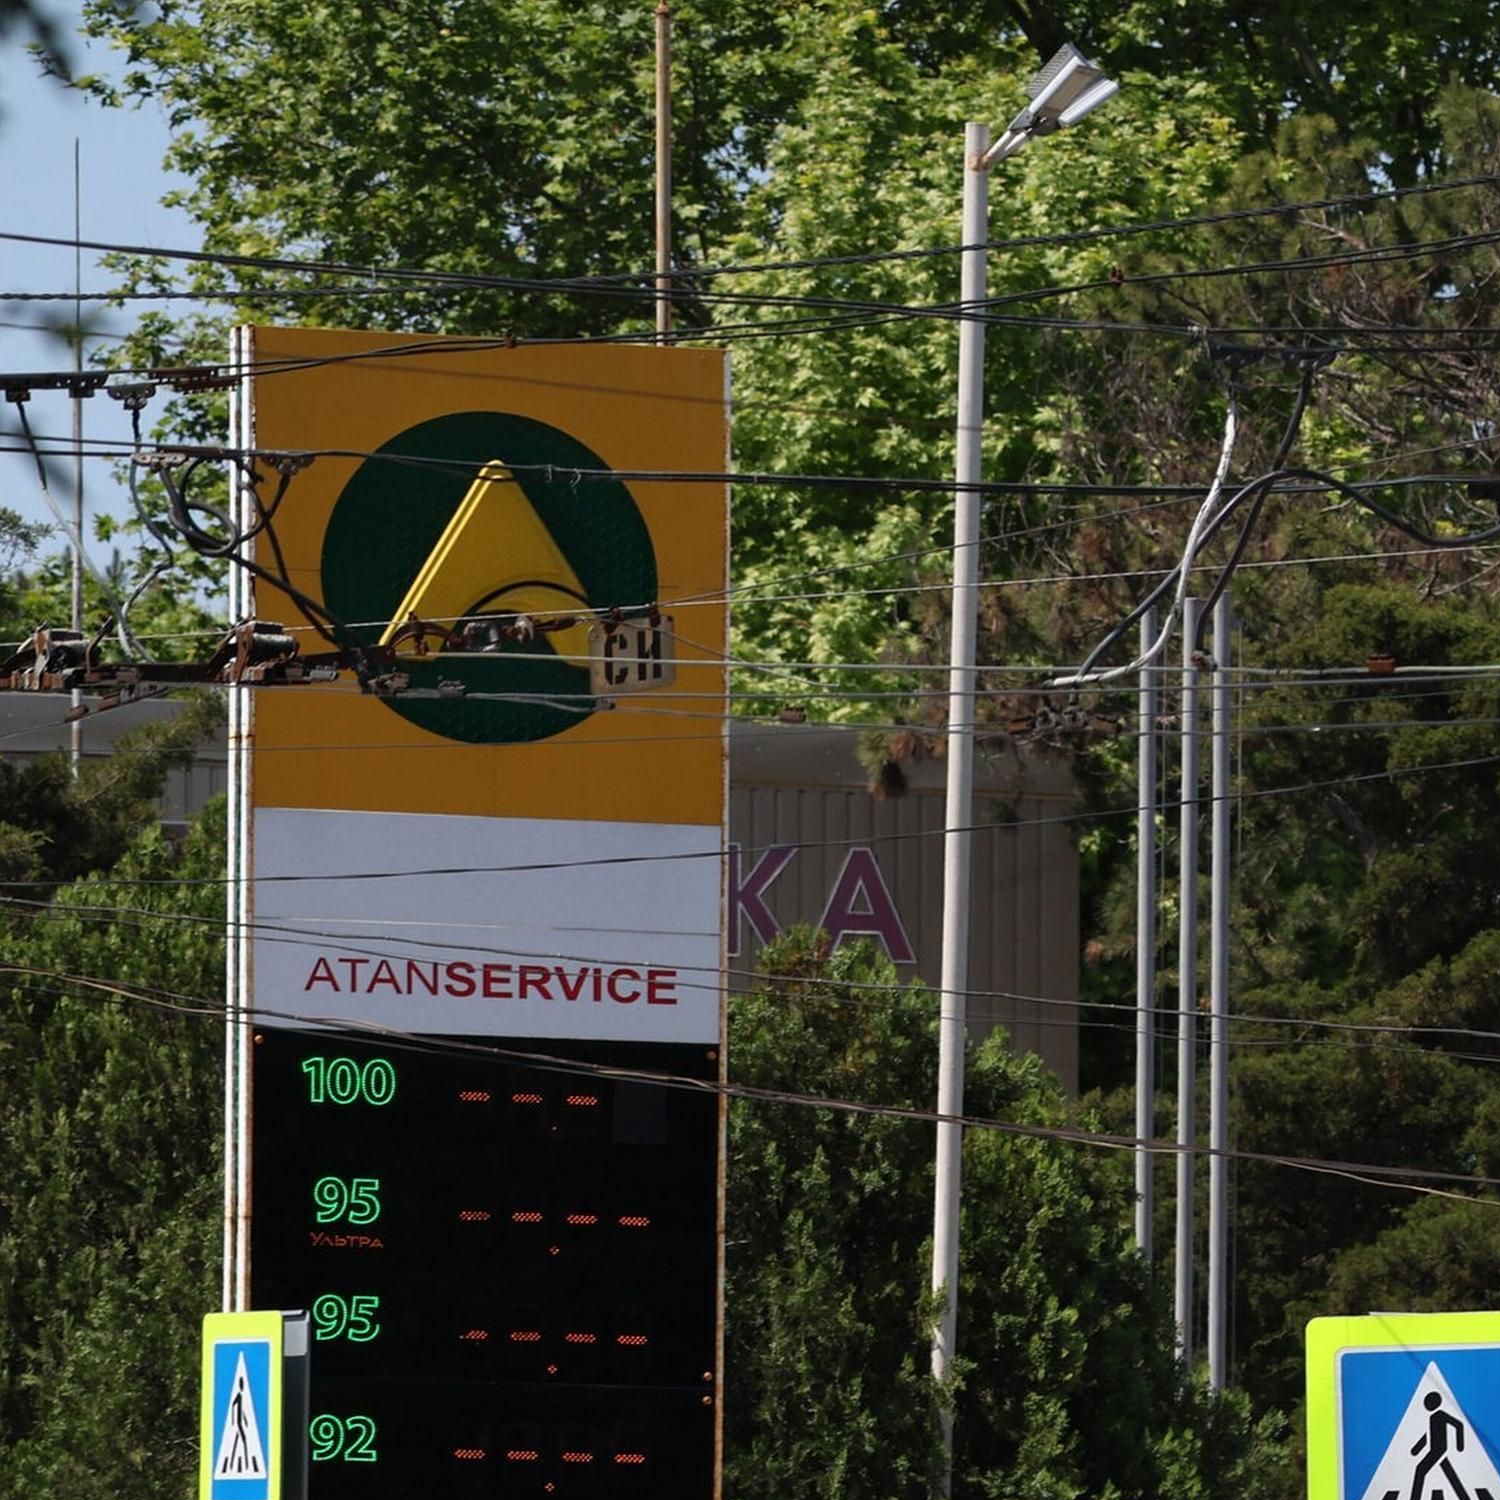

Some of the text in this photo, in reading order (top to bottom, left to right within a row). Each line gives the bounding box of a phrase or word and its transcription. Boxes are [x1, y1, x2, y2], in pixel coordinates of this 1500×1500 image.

[304, 957, 678, 1005] ATANSERVICE
[302, 1057, 396, 1105] 100
[313, 1176, 381, 1225] 95
[313, 1294, 381, 1342] 95
[309, 1415, 378, 1462] 92
